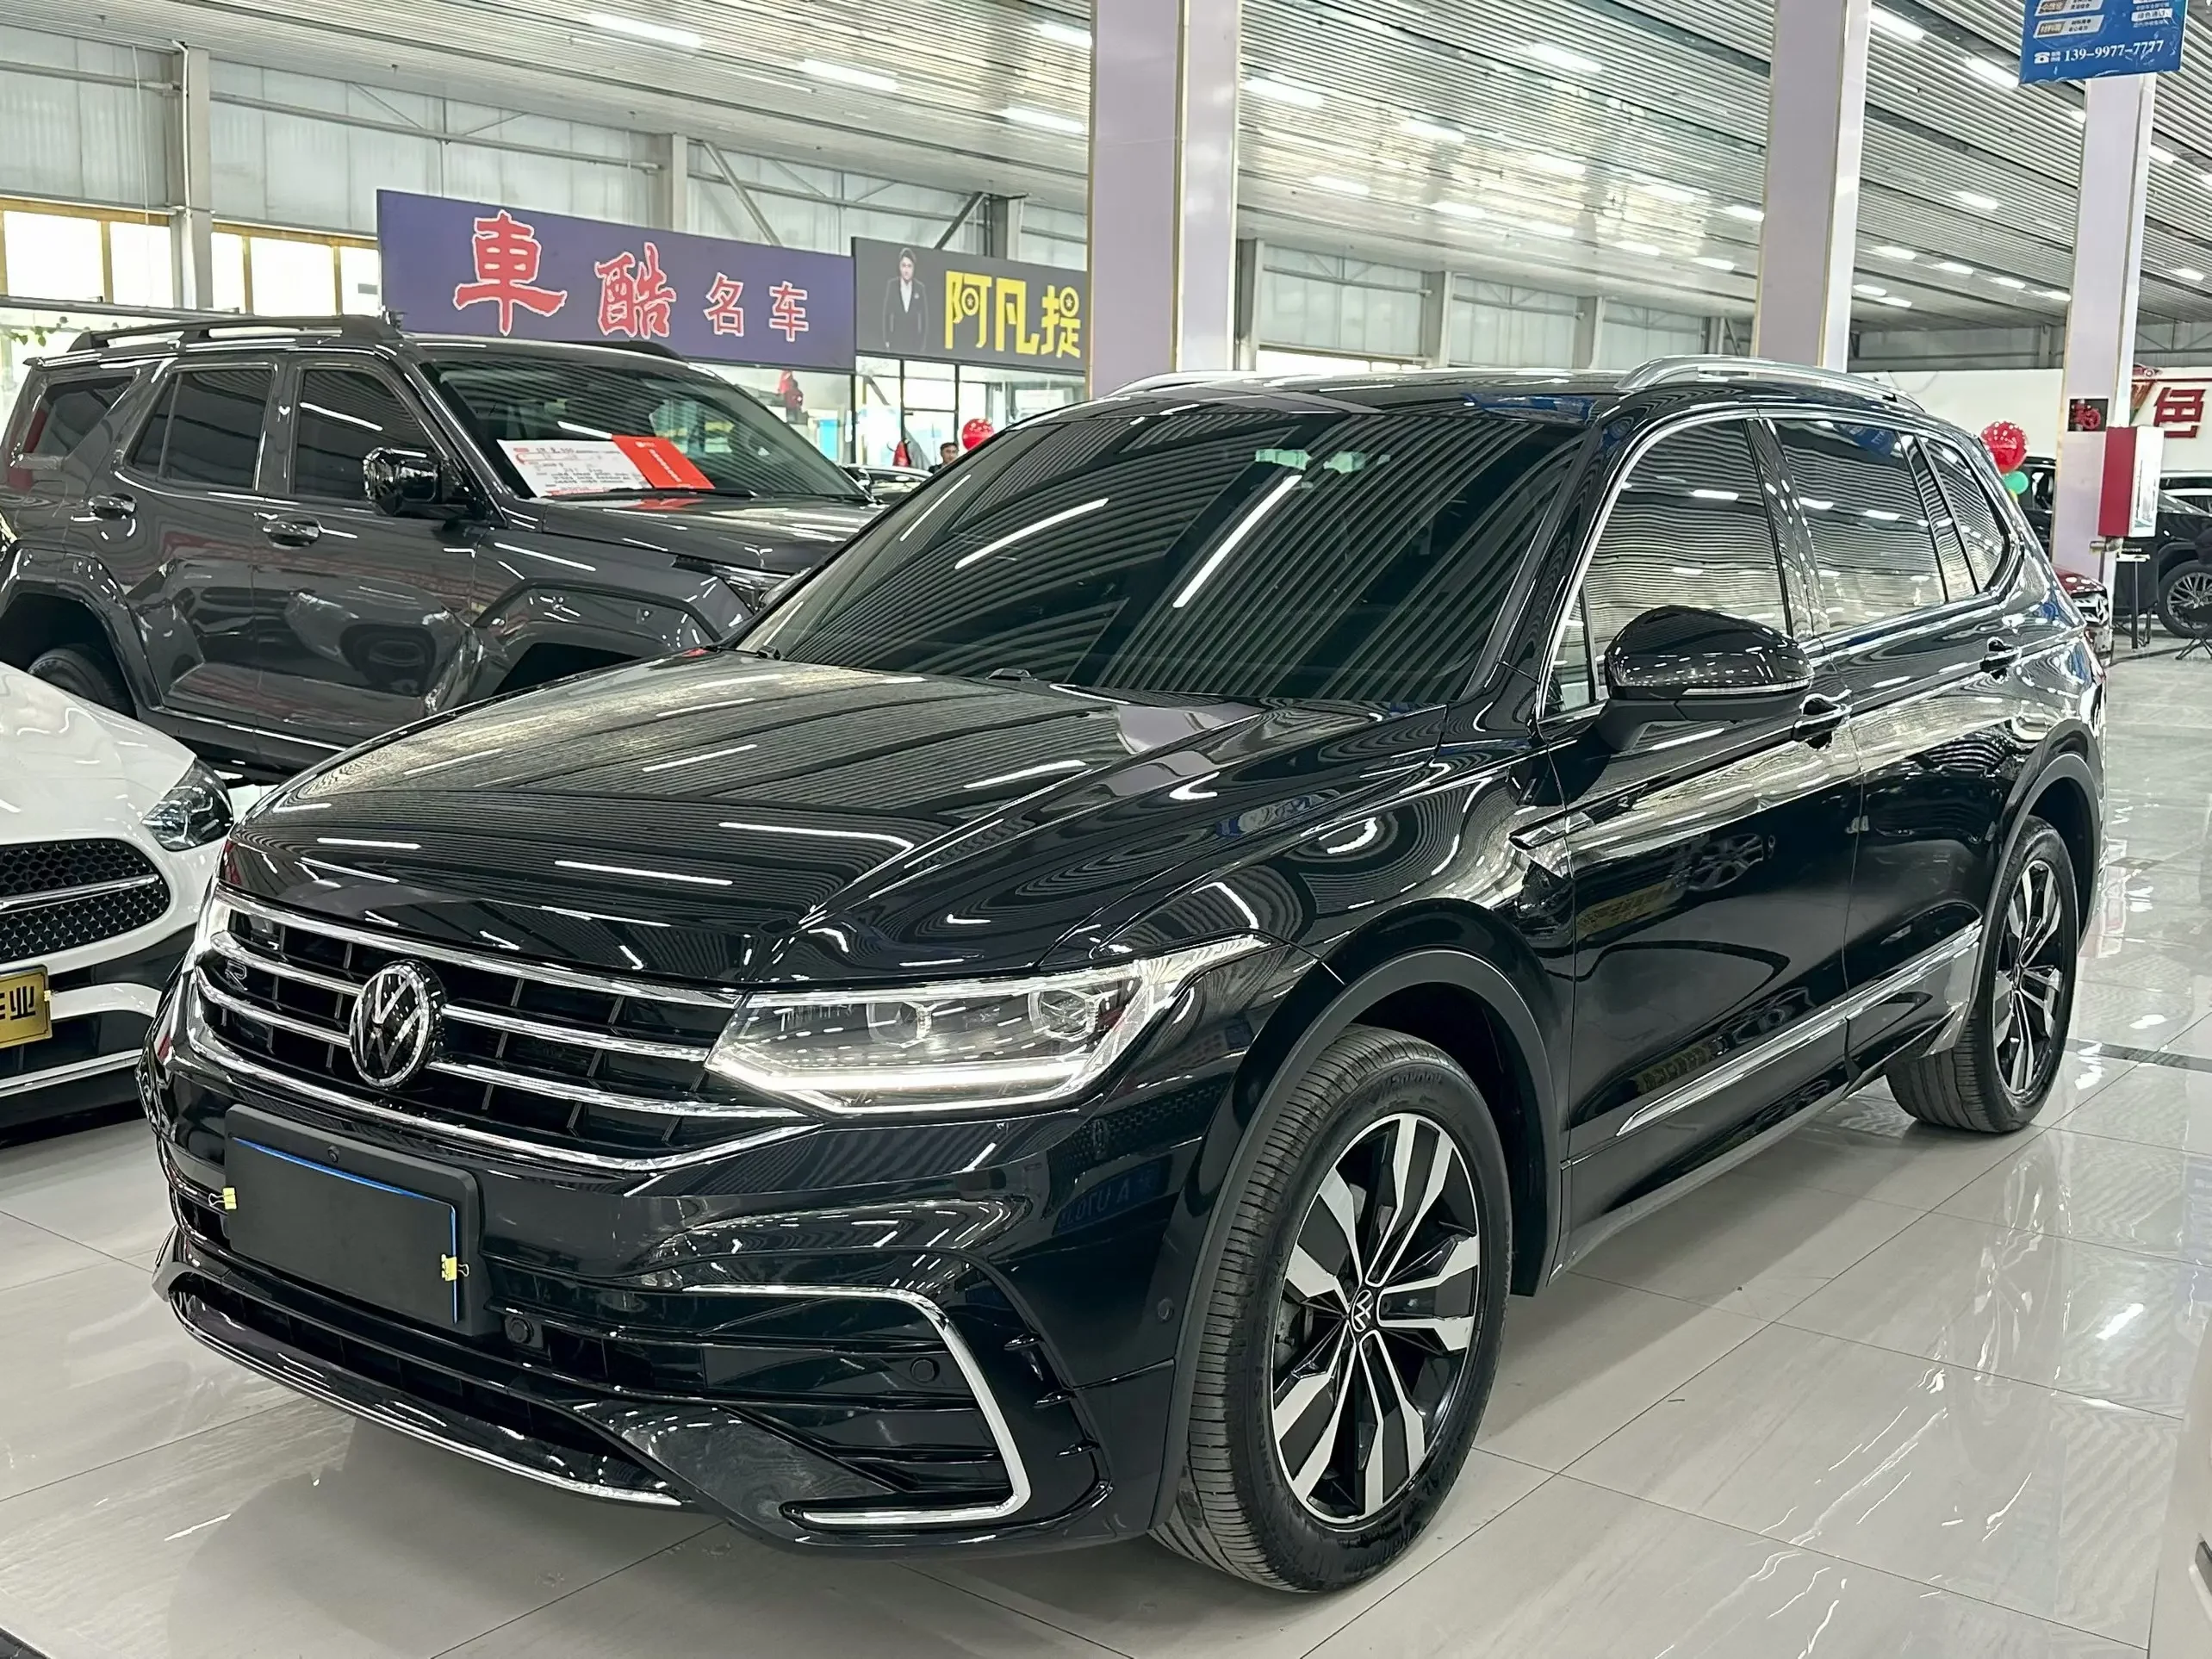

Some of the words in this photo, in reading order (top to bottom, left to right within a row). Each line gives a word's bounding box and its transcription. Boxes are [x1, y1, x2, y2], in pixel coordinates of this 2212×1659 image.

[2064, 40, 2165, 62] 139-9977-7777
[945, 270, 1081, 358] 阿凡提
